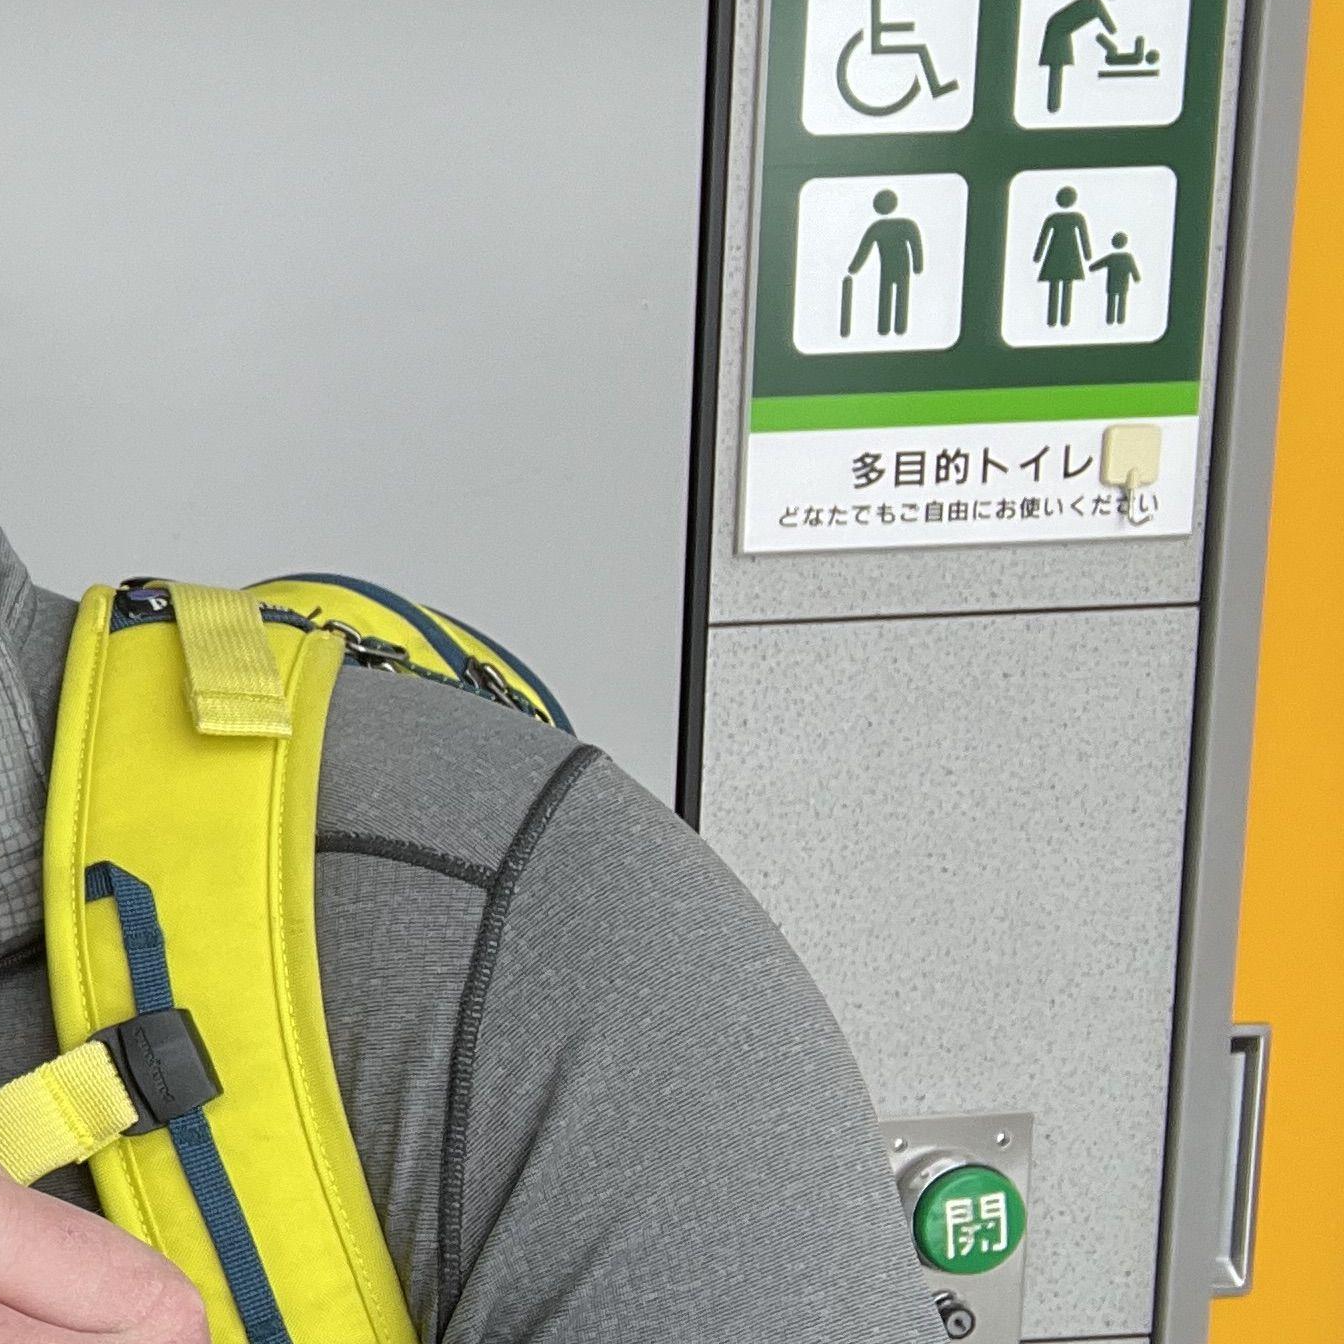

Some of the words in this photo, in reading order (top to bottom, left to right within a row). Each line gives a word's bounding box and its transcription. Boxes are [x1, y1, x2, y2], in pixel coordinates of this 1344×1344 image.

[851, 443, 1095, 489] 多目的トイレ
[945, 1191, 1009, 1260] 開
